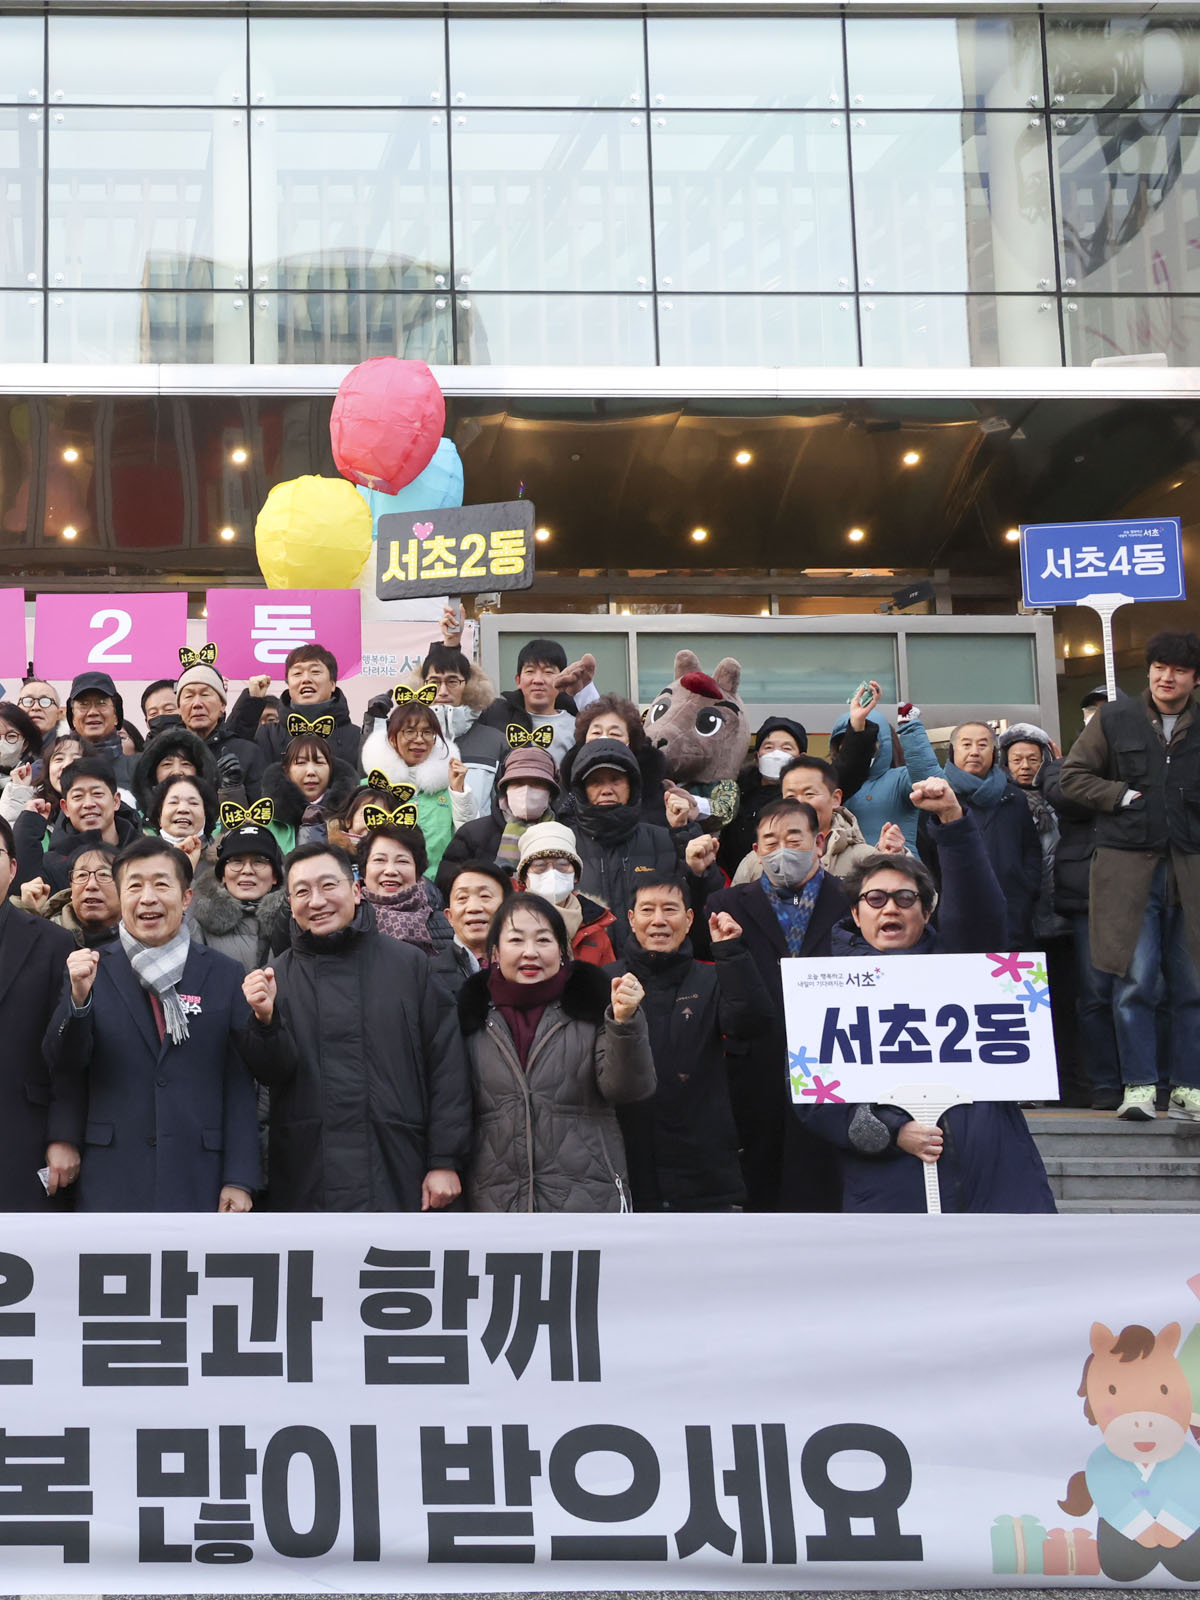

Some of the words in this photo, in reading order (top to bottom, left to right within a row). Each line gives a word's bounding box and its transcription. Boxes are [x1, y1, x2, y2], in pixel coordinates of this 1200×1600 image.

[381, 529, 527, 583] 서초2동
[1040, 543, 1167, 580] 서초4동
[87, 609, 133, 664] 2
[251, 604, 316, 664] 동
[360, 666, 398, 676] 다려지는
[845, 971, 876, 987] 서초
[818, 1003, 1031, 1065] 서초2동
[78, 1249, 324, 1387] 말과
[358, 1245, 601, 1386] 함께
[136, 1423, 381, 1565] 많이
[419, 1422, 924, 1565] 받으세요
